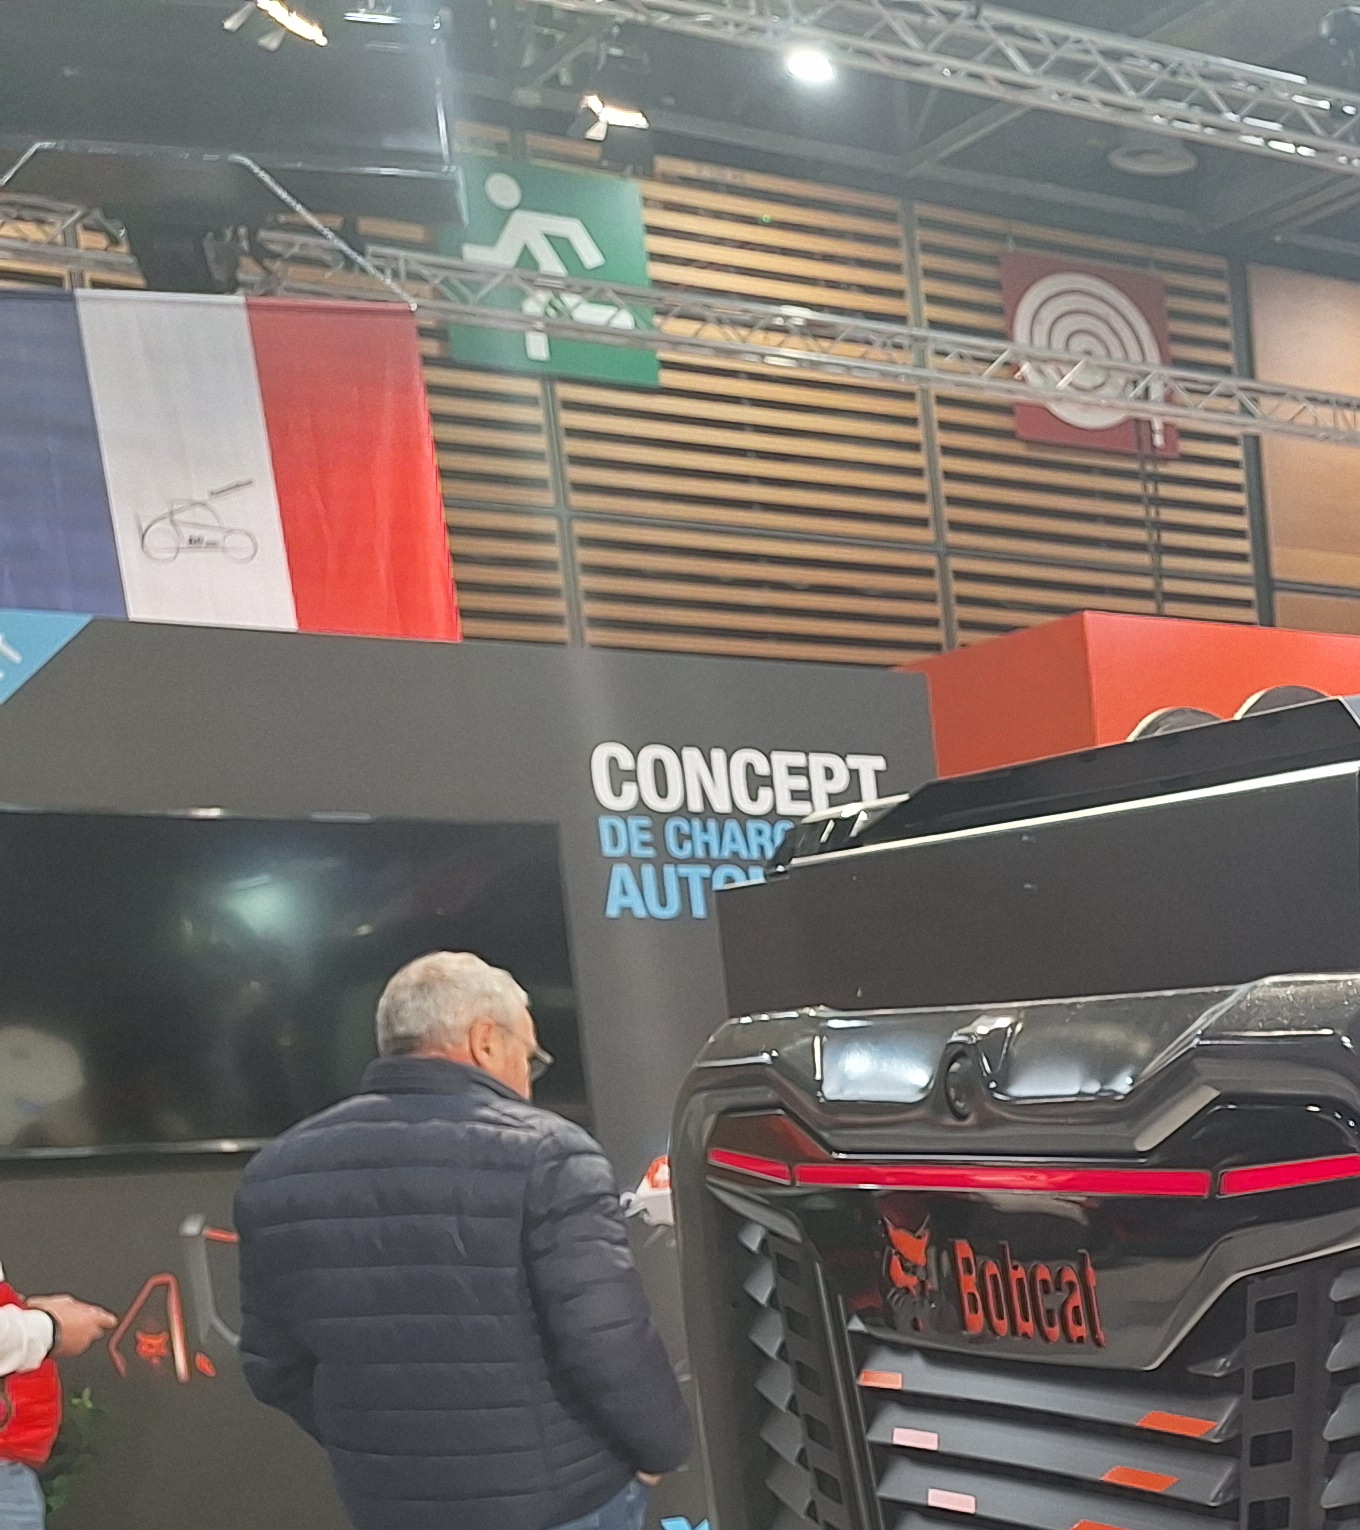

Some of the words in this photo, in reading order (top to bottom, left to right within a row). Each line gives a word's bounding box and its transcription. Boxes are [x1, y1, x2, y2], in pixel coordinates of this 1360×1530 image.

[590, 741, 888, 816] CONCEPT
[598, 815, 657, 859] DE
[604, 863, 766, 920] AUT
[948, 1238, 1107, 1349] Bobcat
